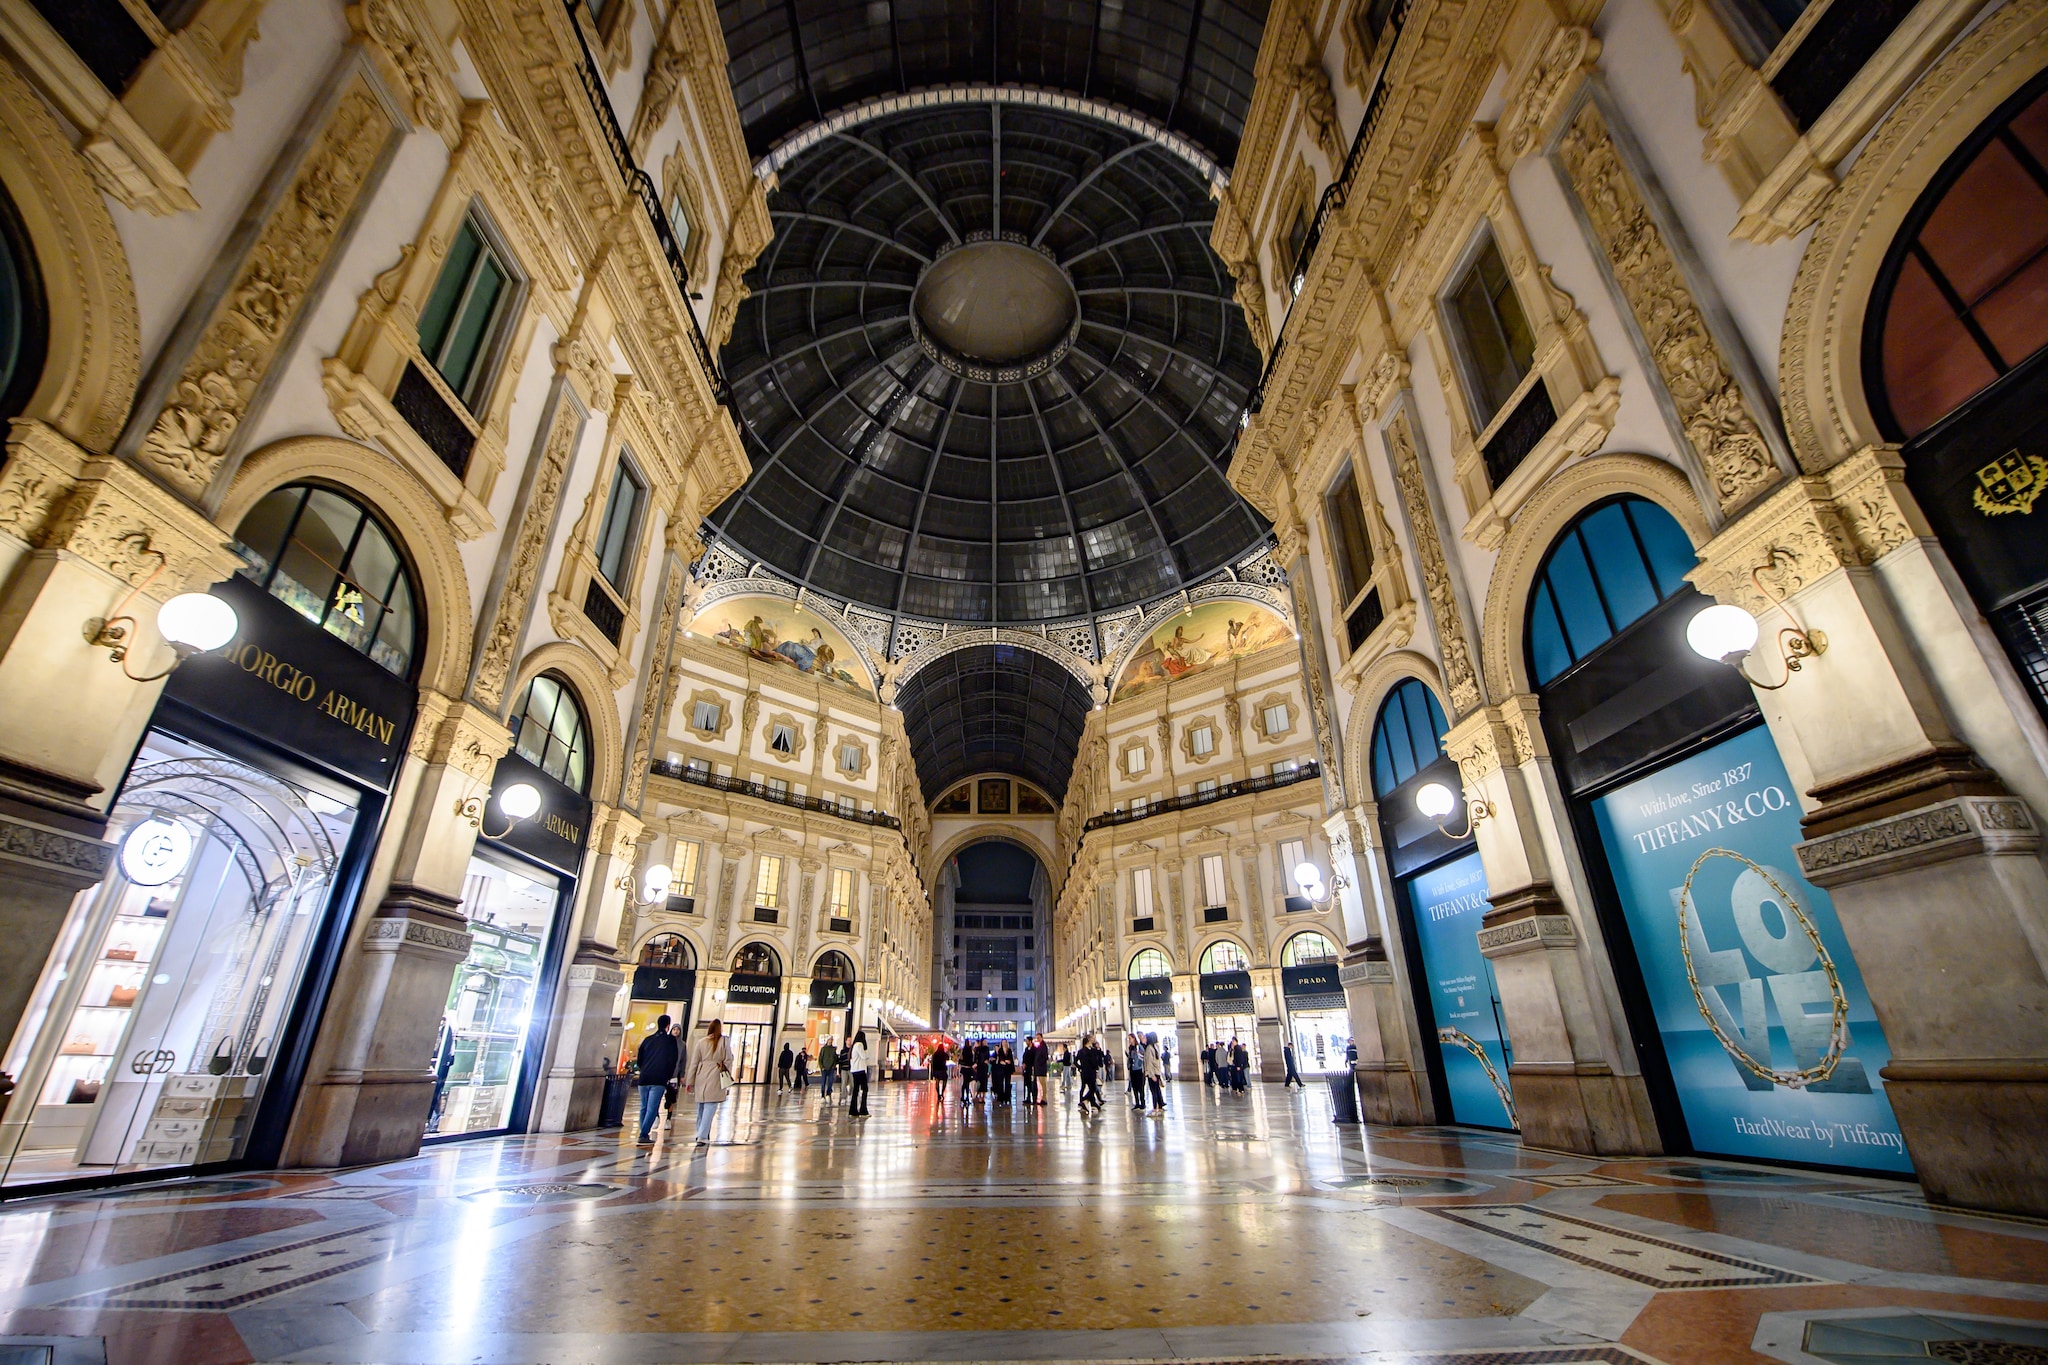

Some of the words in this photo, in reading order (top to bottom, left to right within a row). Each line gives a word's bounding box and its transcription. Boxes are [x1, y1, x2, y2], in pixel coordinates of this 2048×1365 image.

[317, 689, 396, 746] ARMANI
[1640, 797, 1667, 818] With
[1667, 793, 1692, 808] love,
[1692, 780, 1721, 800] Since
[1722, 762, 1752, 788] 1837
[543, 812, 580, 844] ARMANI
[1633, 786, 1791, 855] TIFFANY&CO.
[1470, 869, 1483, 884] 1837
[749, 986, 776, 994] VUITTON
[1214, 983, 1239, 991] PRADA
[1298, 976, 1327, 985] PRADA
[1732, 1117, 1812, 1140] HardWear
[1811, 1120, 1834, 1148] by
[1834, 1123, 1903, 1155] Tiffany
